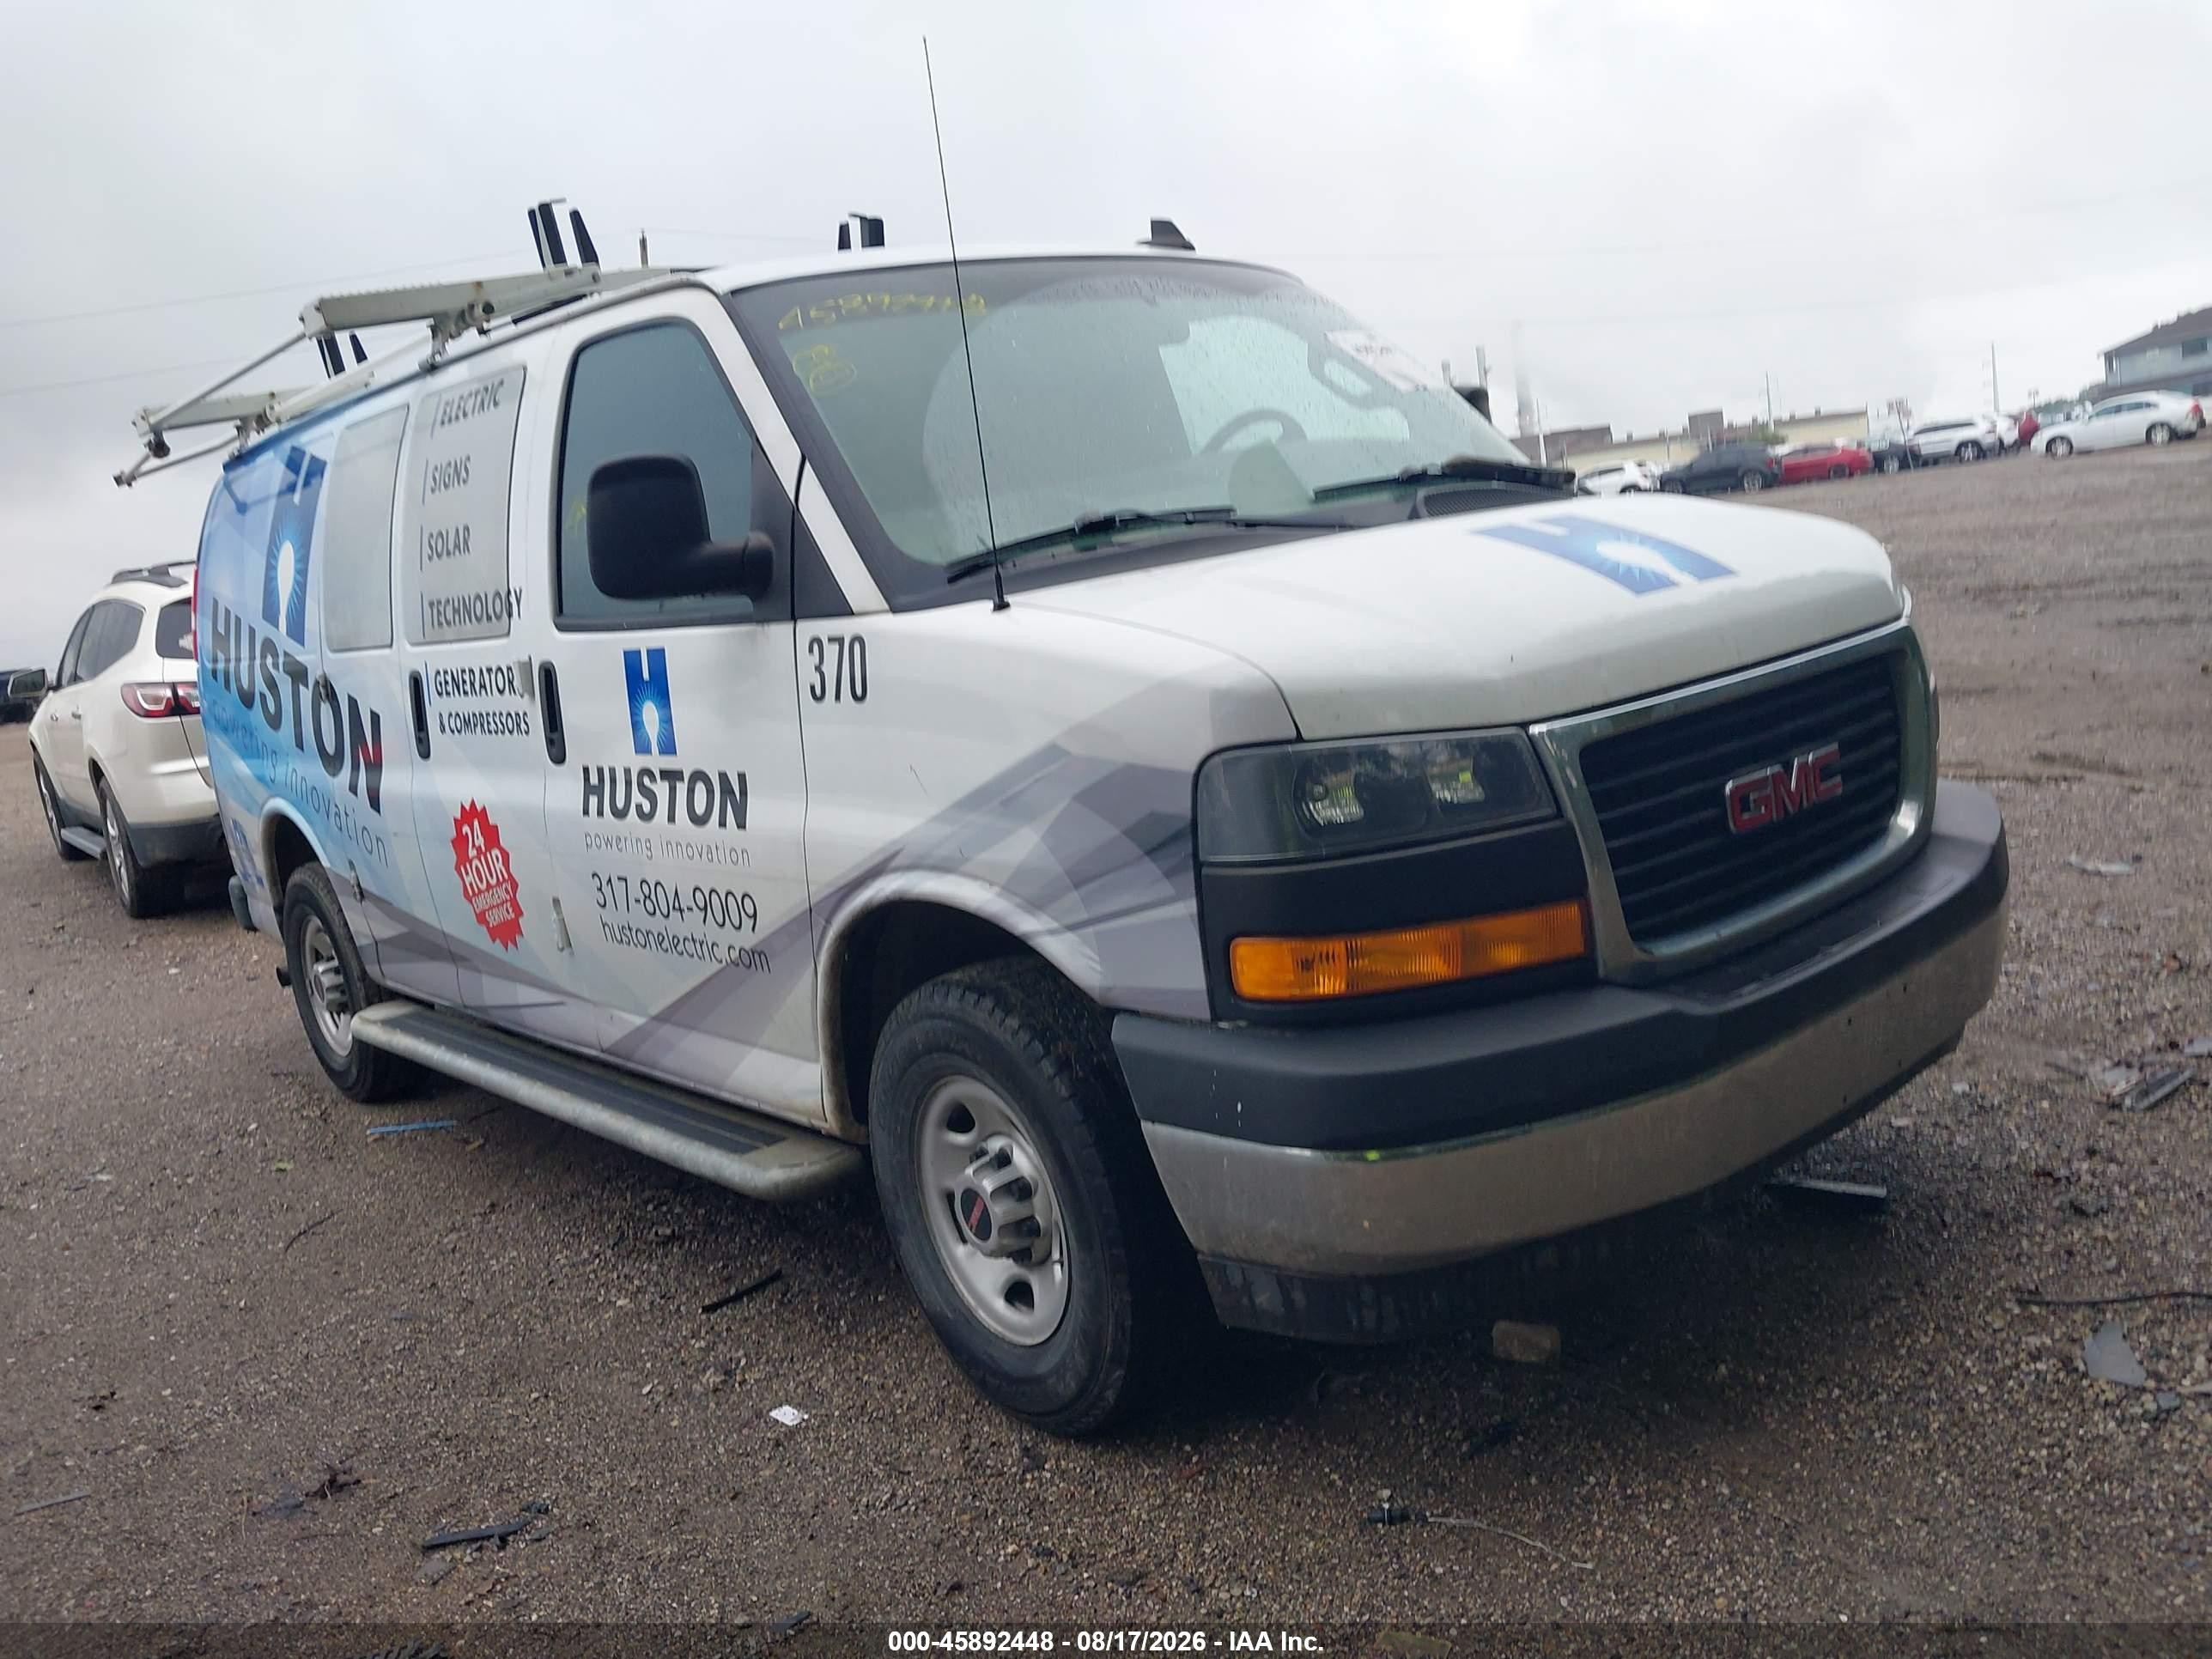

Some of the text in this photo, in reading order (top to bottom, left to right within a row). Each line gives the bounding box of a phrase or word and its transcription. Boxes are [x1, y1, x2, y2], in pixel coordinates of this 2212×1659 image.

[440, 379, 505, 426] ELECTRIC
[429, 456, 471, 495] SIGNS
[427, 525, 471, 561] SOLAR
[428, 588, 523, 631] TECHNOLOGY
[807, 634, 869, 704] 370
[210, 597, 384, 817] HUSTON
[439, 711, 531, 737] & COMPRESSORS
[286, 754, 391, 869] innovation
[580, 764, 750, 831] HUSTON
[1724, 741, 1843, 835] GMC
[461, 817, 486, 860] 24
[584, 831, 751, 867] powering innovation
[460, 847, 509, 896] HOUR
[591, 872, 758, 933] 317-804-9009
[600, 914, 771, 974] hustonelectric.com
